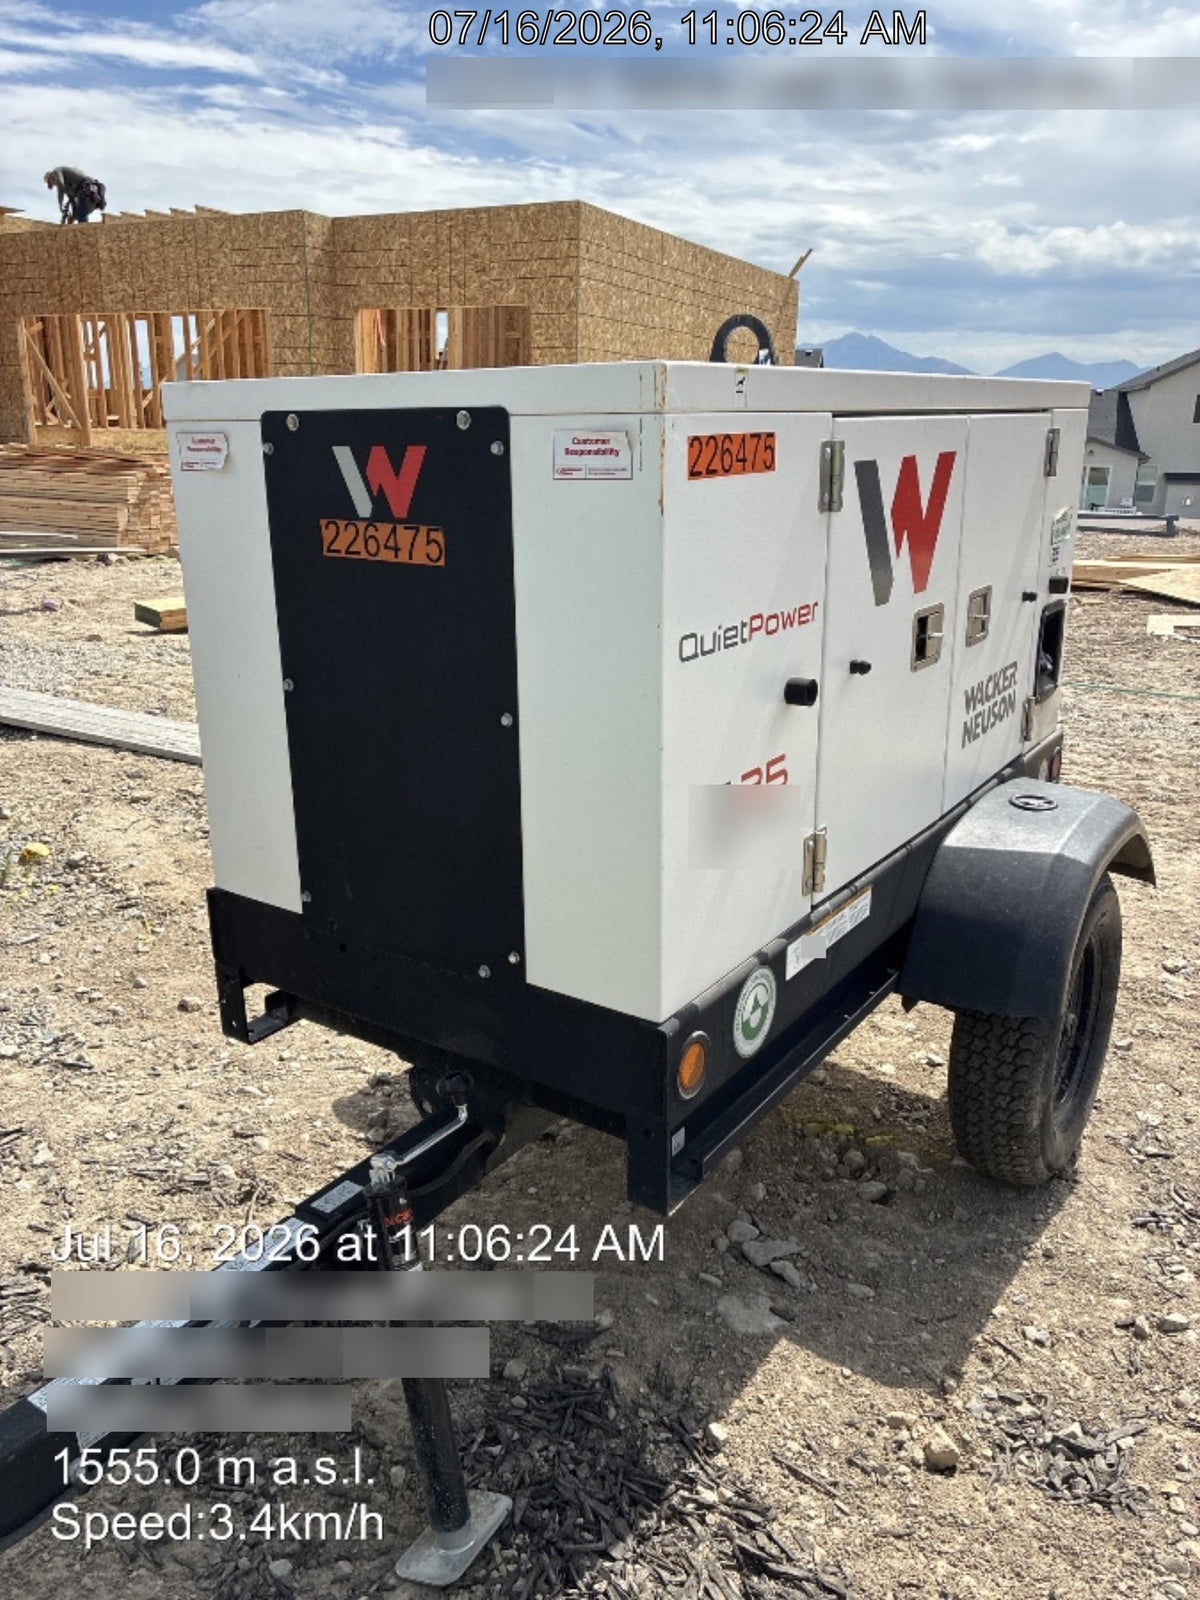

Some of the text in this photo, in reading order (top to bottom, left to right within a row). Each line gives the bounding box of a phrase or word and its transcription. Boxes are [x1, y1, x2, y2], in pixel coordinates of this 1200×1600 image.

[688, 431, 775, 477] 226475
[324, 519, 444, 564] 226475
[678, 600, 819, 663] QuietPower
[963, 660, 1018, 716] WACKER
[961, 688, 1017, 750] NEUSON
